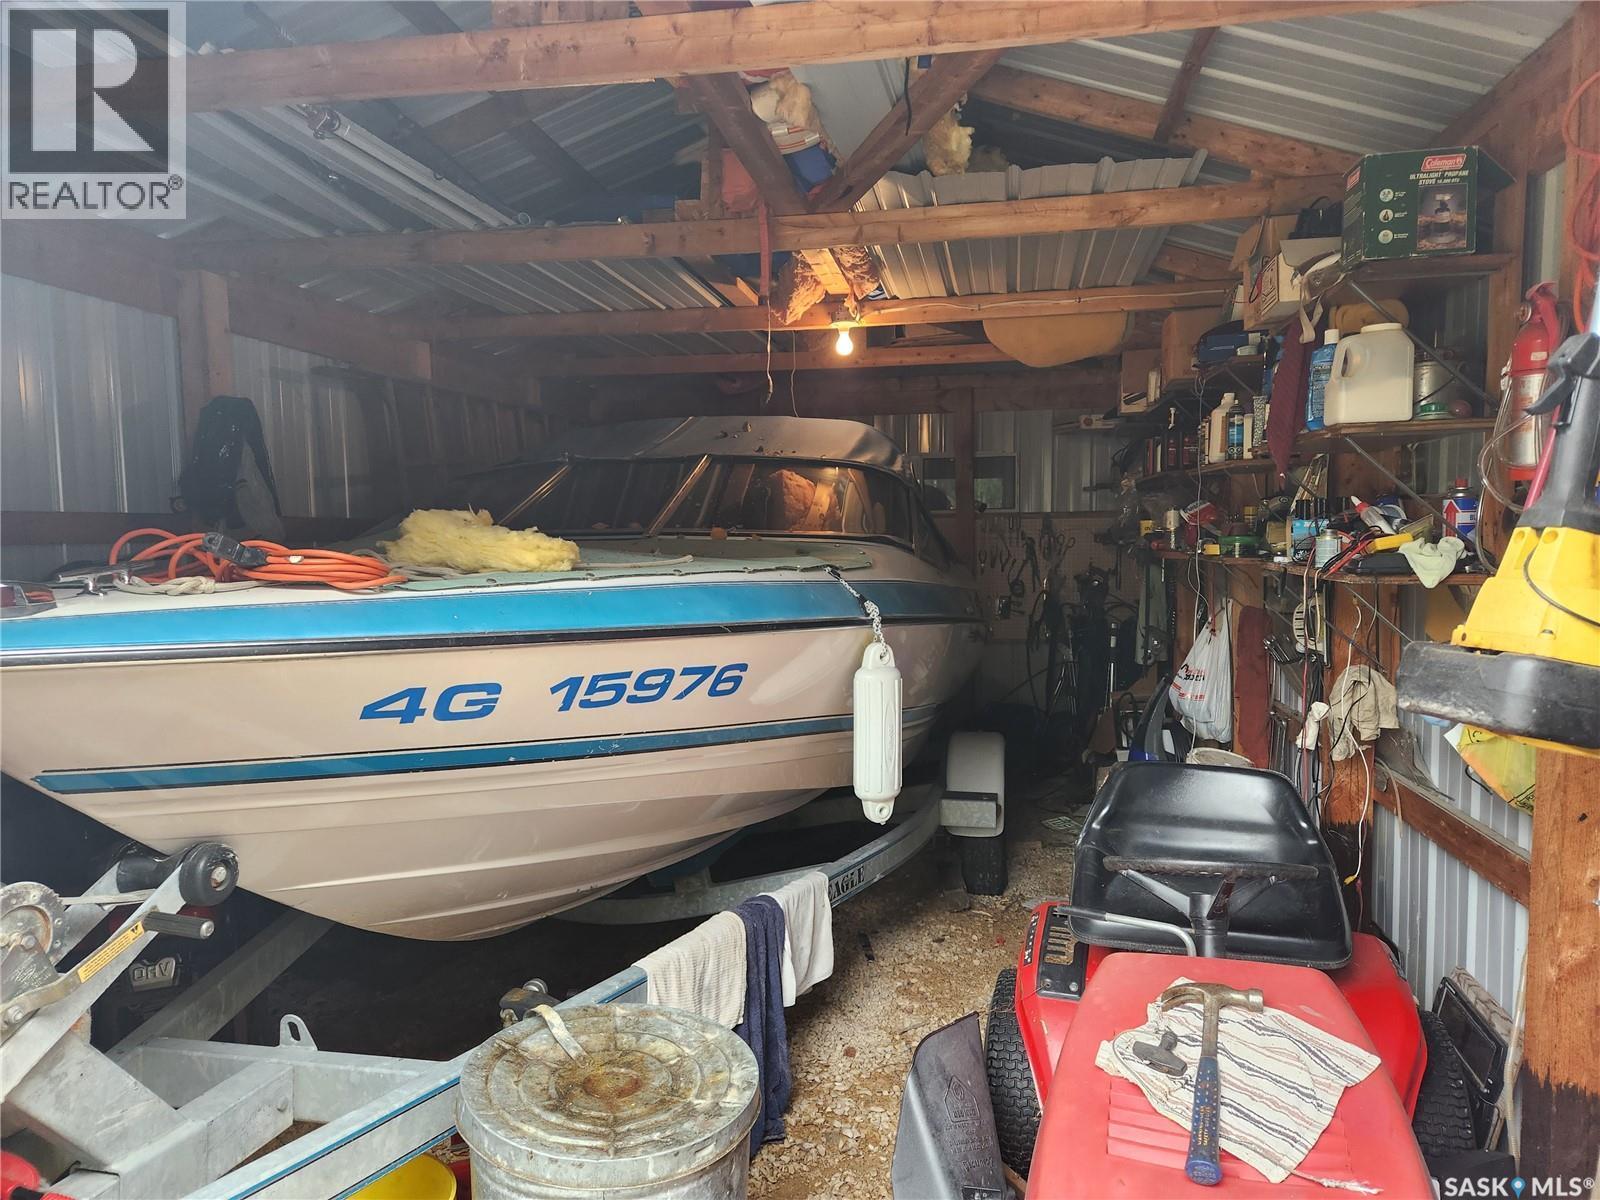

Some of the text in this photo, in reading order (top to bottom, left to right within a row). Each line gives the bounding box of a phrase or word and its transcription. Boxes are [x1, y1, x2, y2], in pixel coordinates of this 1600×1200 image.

[1425, 158, 1455, 168] Coleman
[1418, 178, 1437, 186] STOVE
[358, 662, 749, 724] 4G 15976
